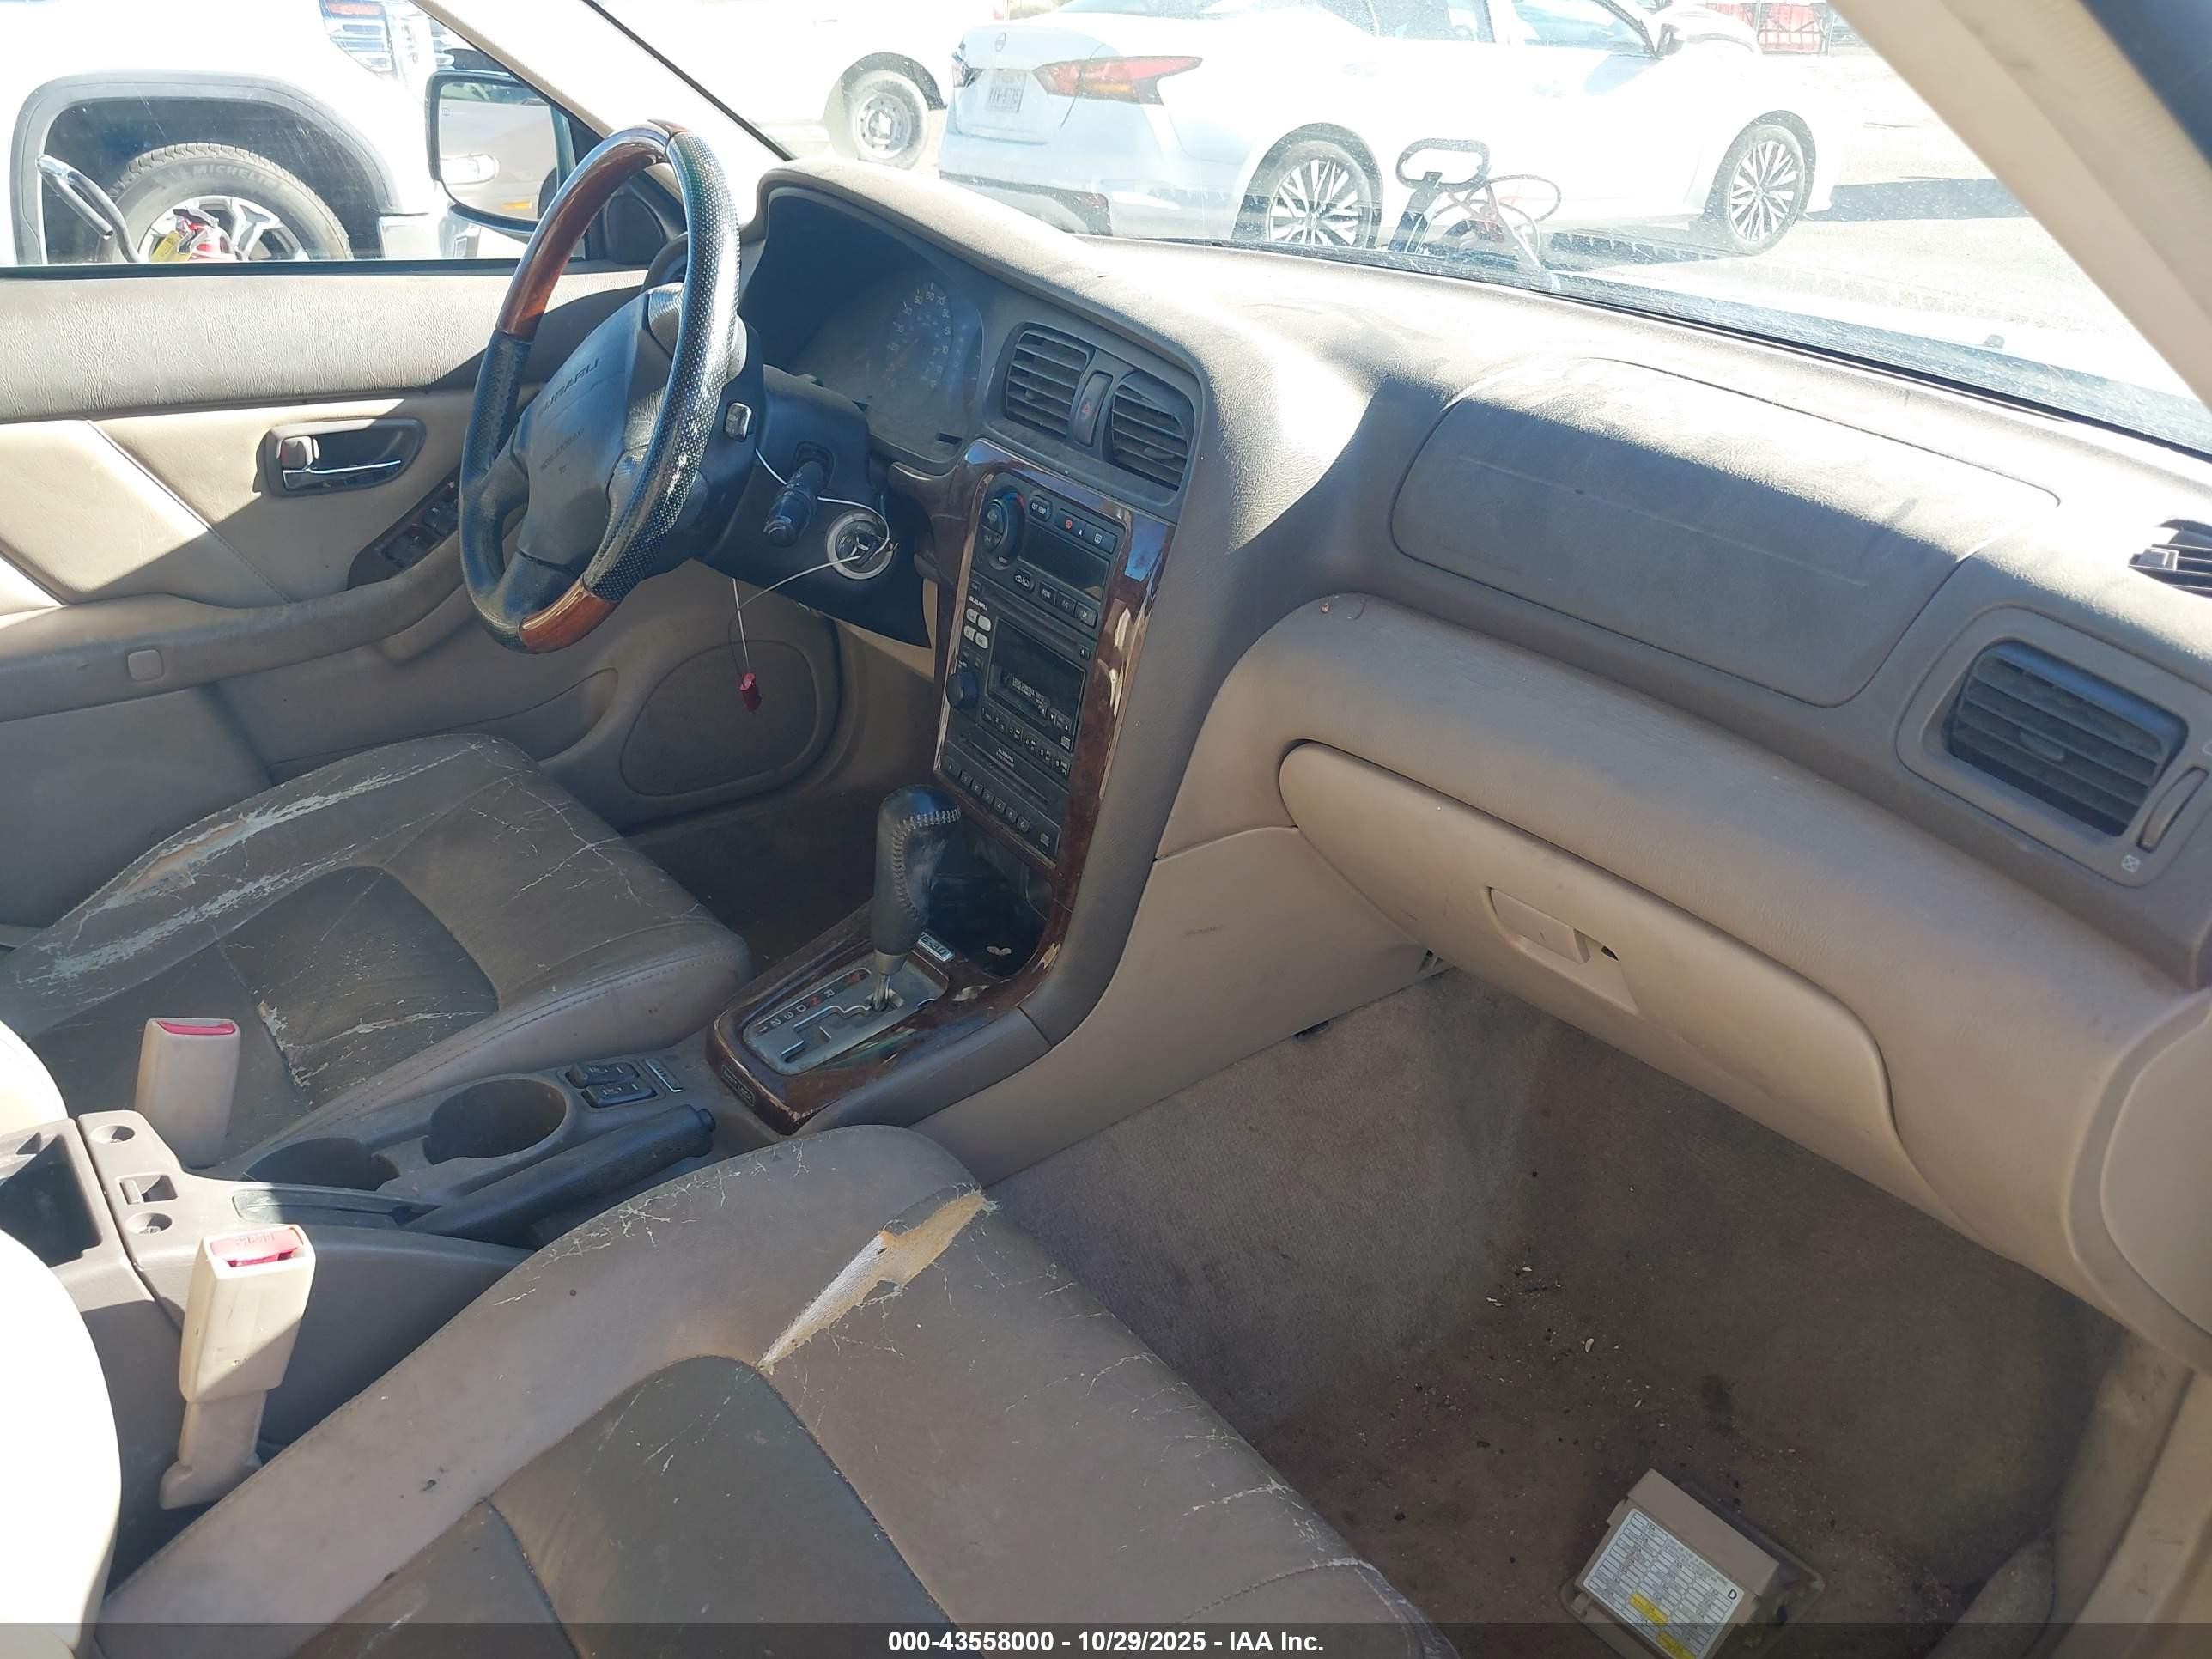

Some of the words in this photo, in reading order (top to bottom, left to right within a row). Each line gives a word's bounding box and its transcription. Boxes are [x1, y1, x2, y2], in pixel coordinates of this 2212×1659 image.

[969, 595, 988, 611] SUBARU
[824, 988, 835, 997] R
[795, 1004, 806, 1012] D
[784, 1012, 794, 1020] 3
[770, 1018, 781, 1027] 2
[1727, 1589, 1737, 1600] D
